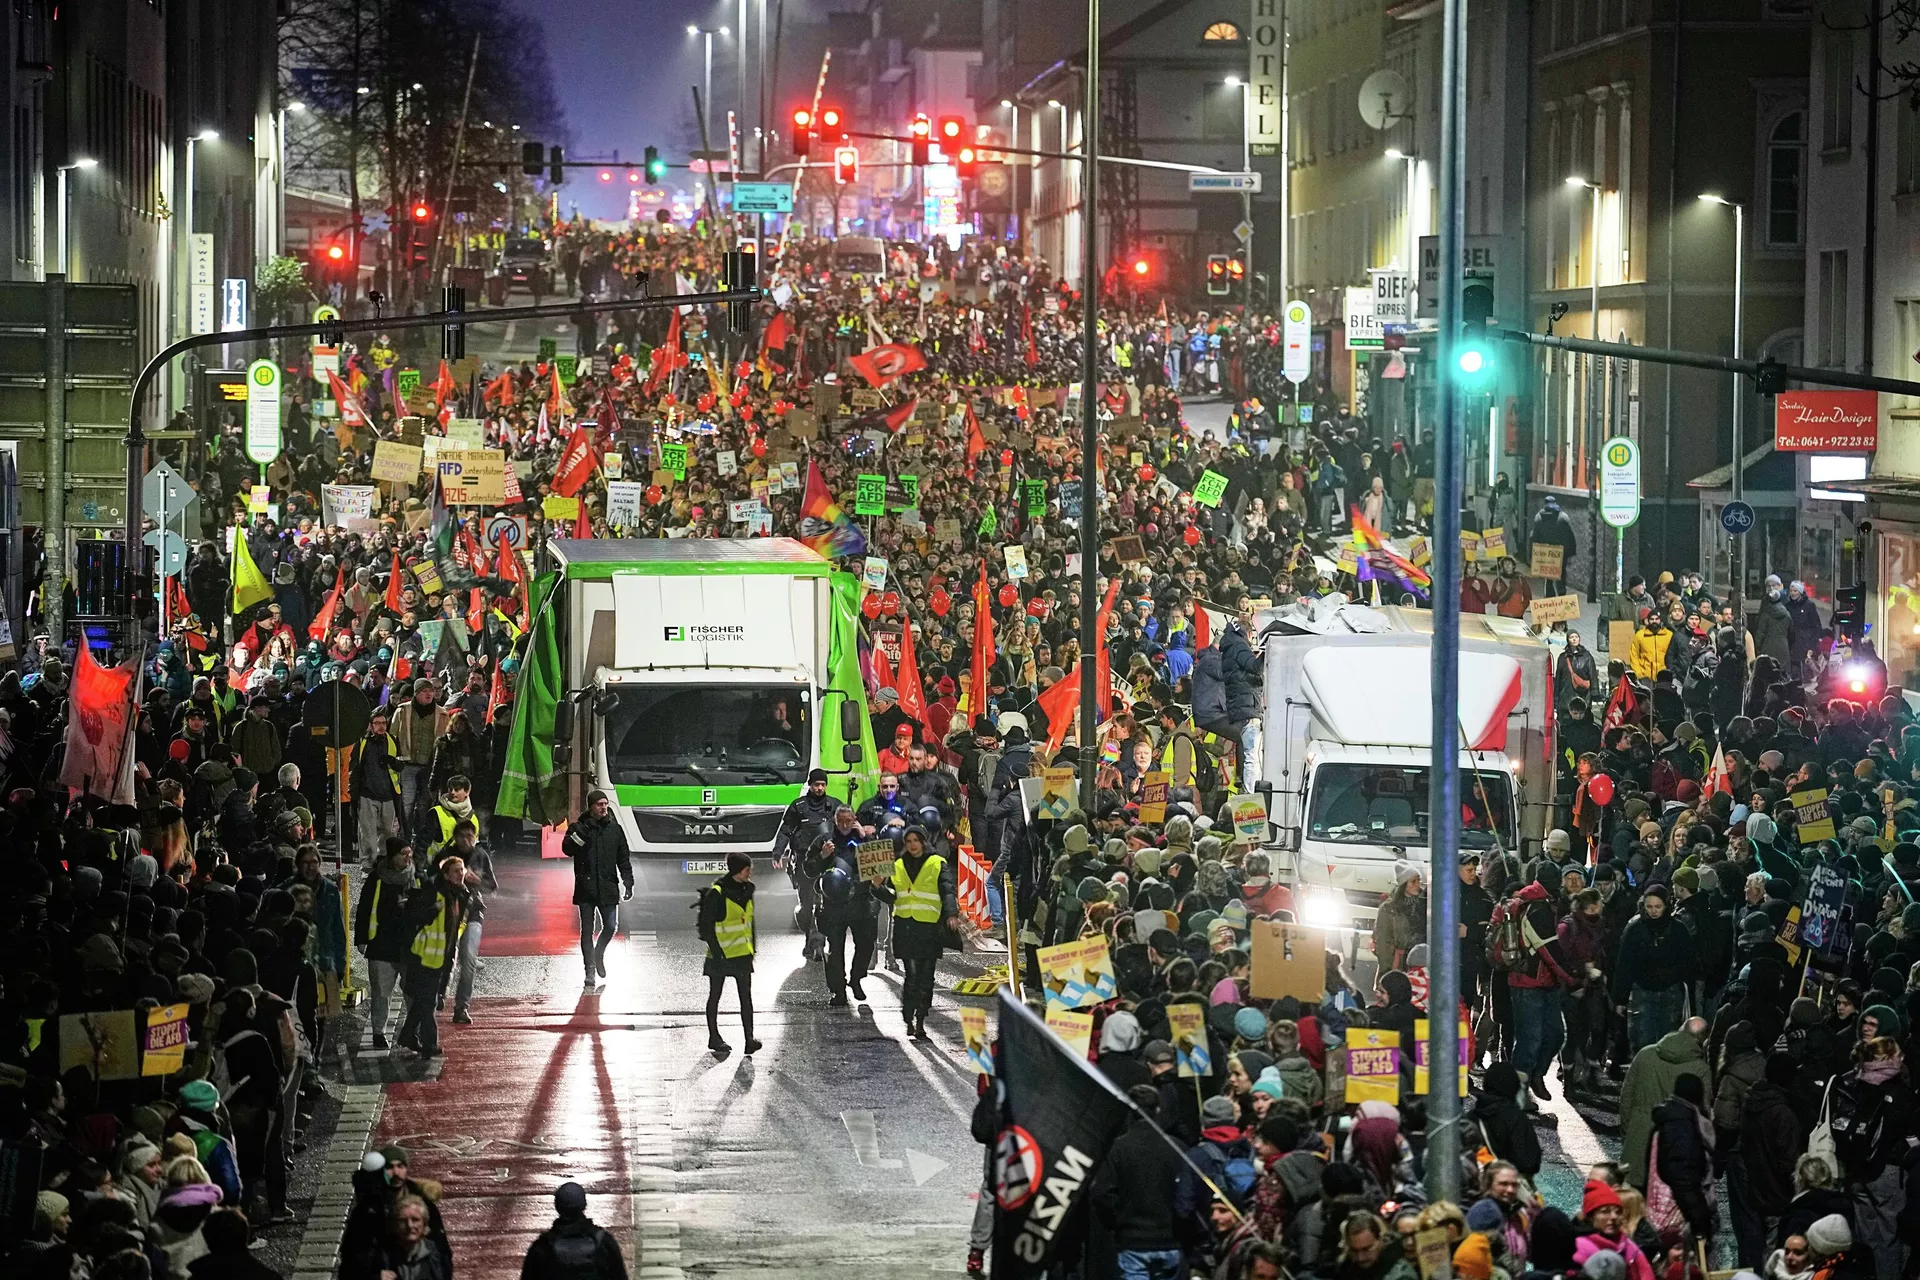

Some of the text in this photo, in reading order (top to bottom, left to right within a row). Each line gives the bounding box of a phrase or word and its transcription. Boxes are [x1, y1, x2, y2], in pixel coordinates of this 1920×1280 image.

[1256, 0, 1276, 135] HOTEL
[1425, 249, 1495, 267] MBEL
[1779, 436, 1799, 447] Tel.:
[1801, 436, 1823, 447] 0641
[1831, 436, 1848, 447] 972
[1849, 436, 1861, 447] 23
[1863, 436, 1875, 447] 82
[437, 452, 463, 460] EINFACHE
[662, 450, 685, 460] FCK
[439, 462, 462, 475] AFD
[662, 460, 685, 468] AFD
[858, 482, 883, 493] FCK
[1198, 483, 1221, 497] AFD
[1202, 476, 1222, 491] FCK
[445, 488, 467, 502] AZIS
[858, 491, 884, 502] AFD
[690, 625, 744, 633] FISCHER
[690, 633, 744, 641] LOGISTIK
[1797, 802, 1825, 817] STOPPT
[1800, 810, 1828, 824] DIE AFD
[685, 824, 734, 835] MAN
[861, 866, 878, 877] FCK
[150, 1021, 182, 1037] STOPPT
[150, 1032, 182, 1049] DIE AFD
[1351, 1049, 1393, 1062] STOPPT
[1352, 1061, 1394, 1075] DIE AFD
